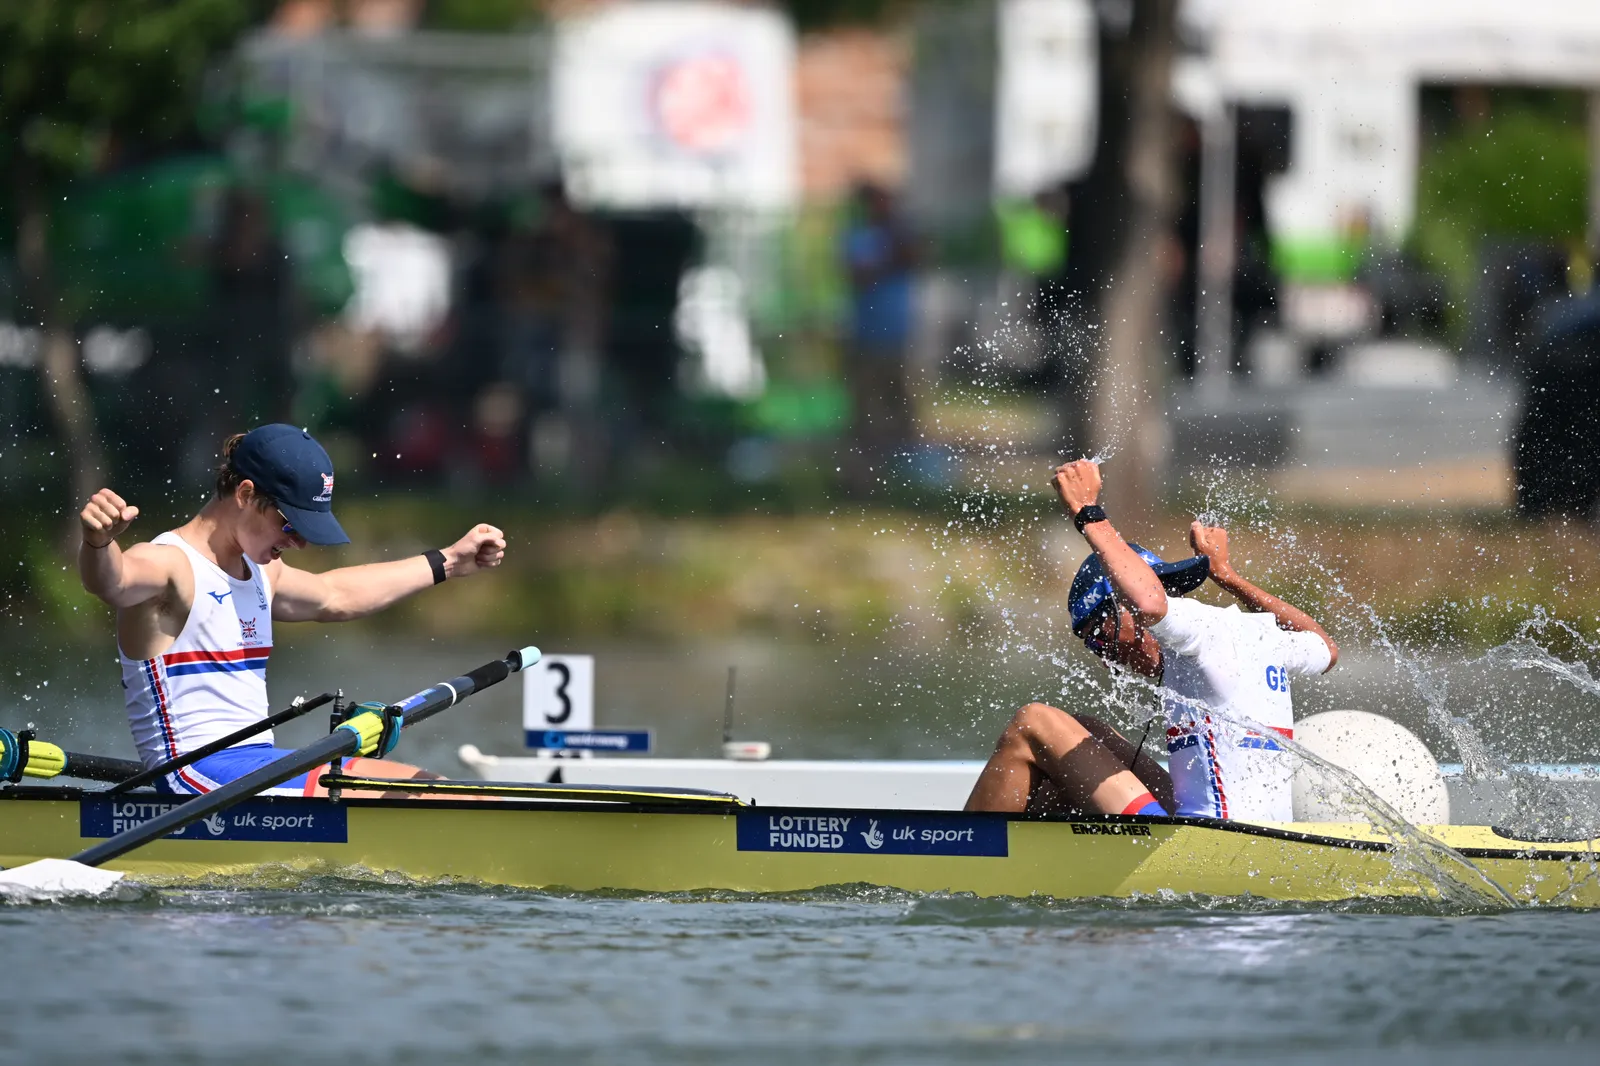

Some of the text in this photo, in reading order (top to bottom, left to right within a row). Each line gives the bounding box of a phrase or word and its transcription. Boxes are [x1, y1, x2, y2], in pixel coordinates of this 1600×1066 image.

[1083, 587, 1101, 609] NK
[544, 662, 572, 725] 3
[112, 803, 183, 818] LOTTE
[233, 812, 314, 830] uk sport
[769, 815, 851, 832] LOTTERY
[892, 825, 974, 844] uk sport
[1070, 824, 1151, 836] EMPACHER
[769, 832, 844, 849] FUNDED
